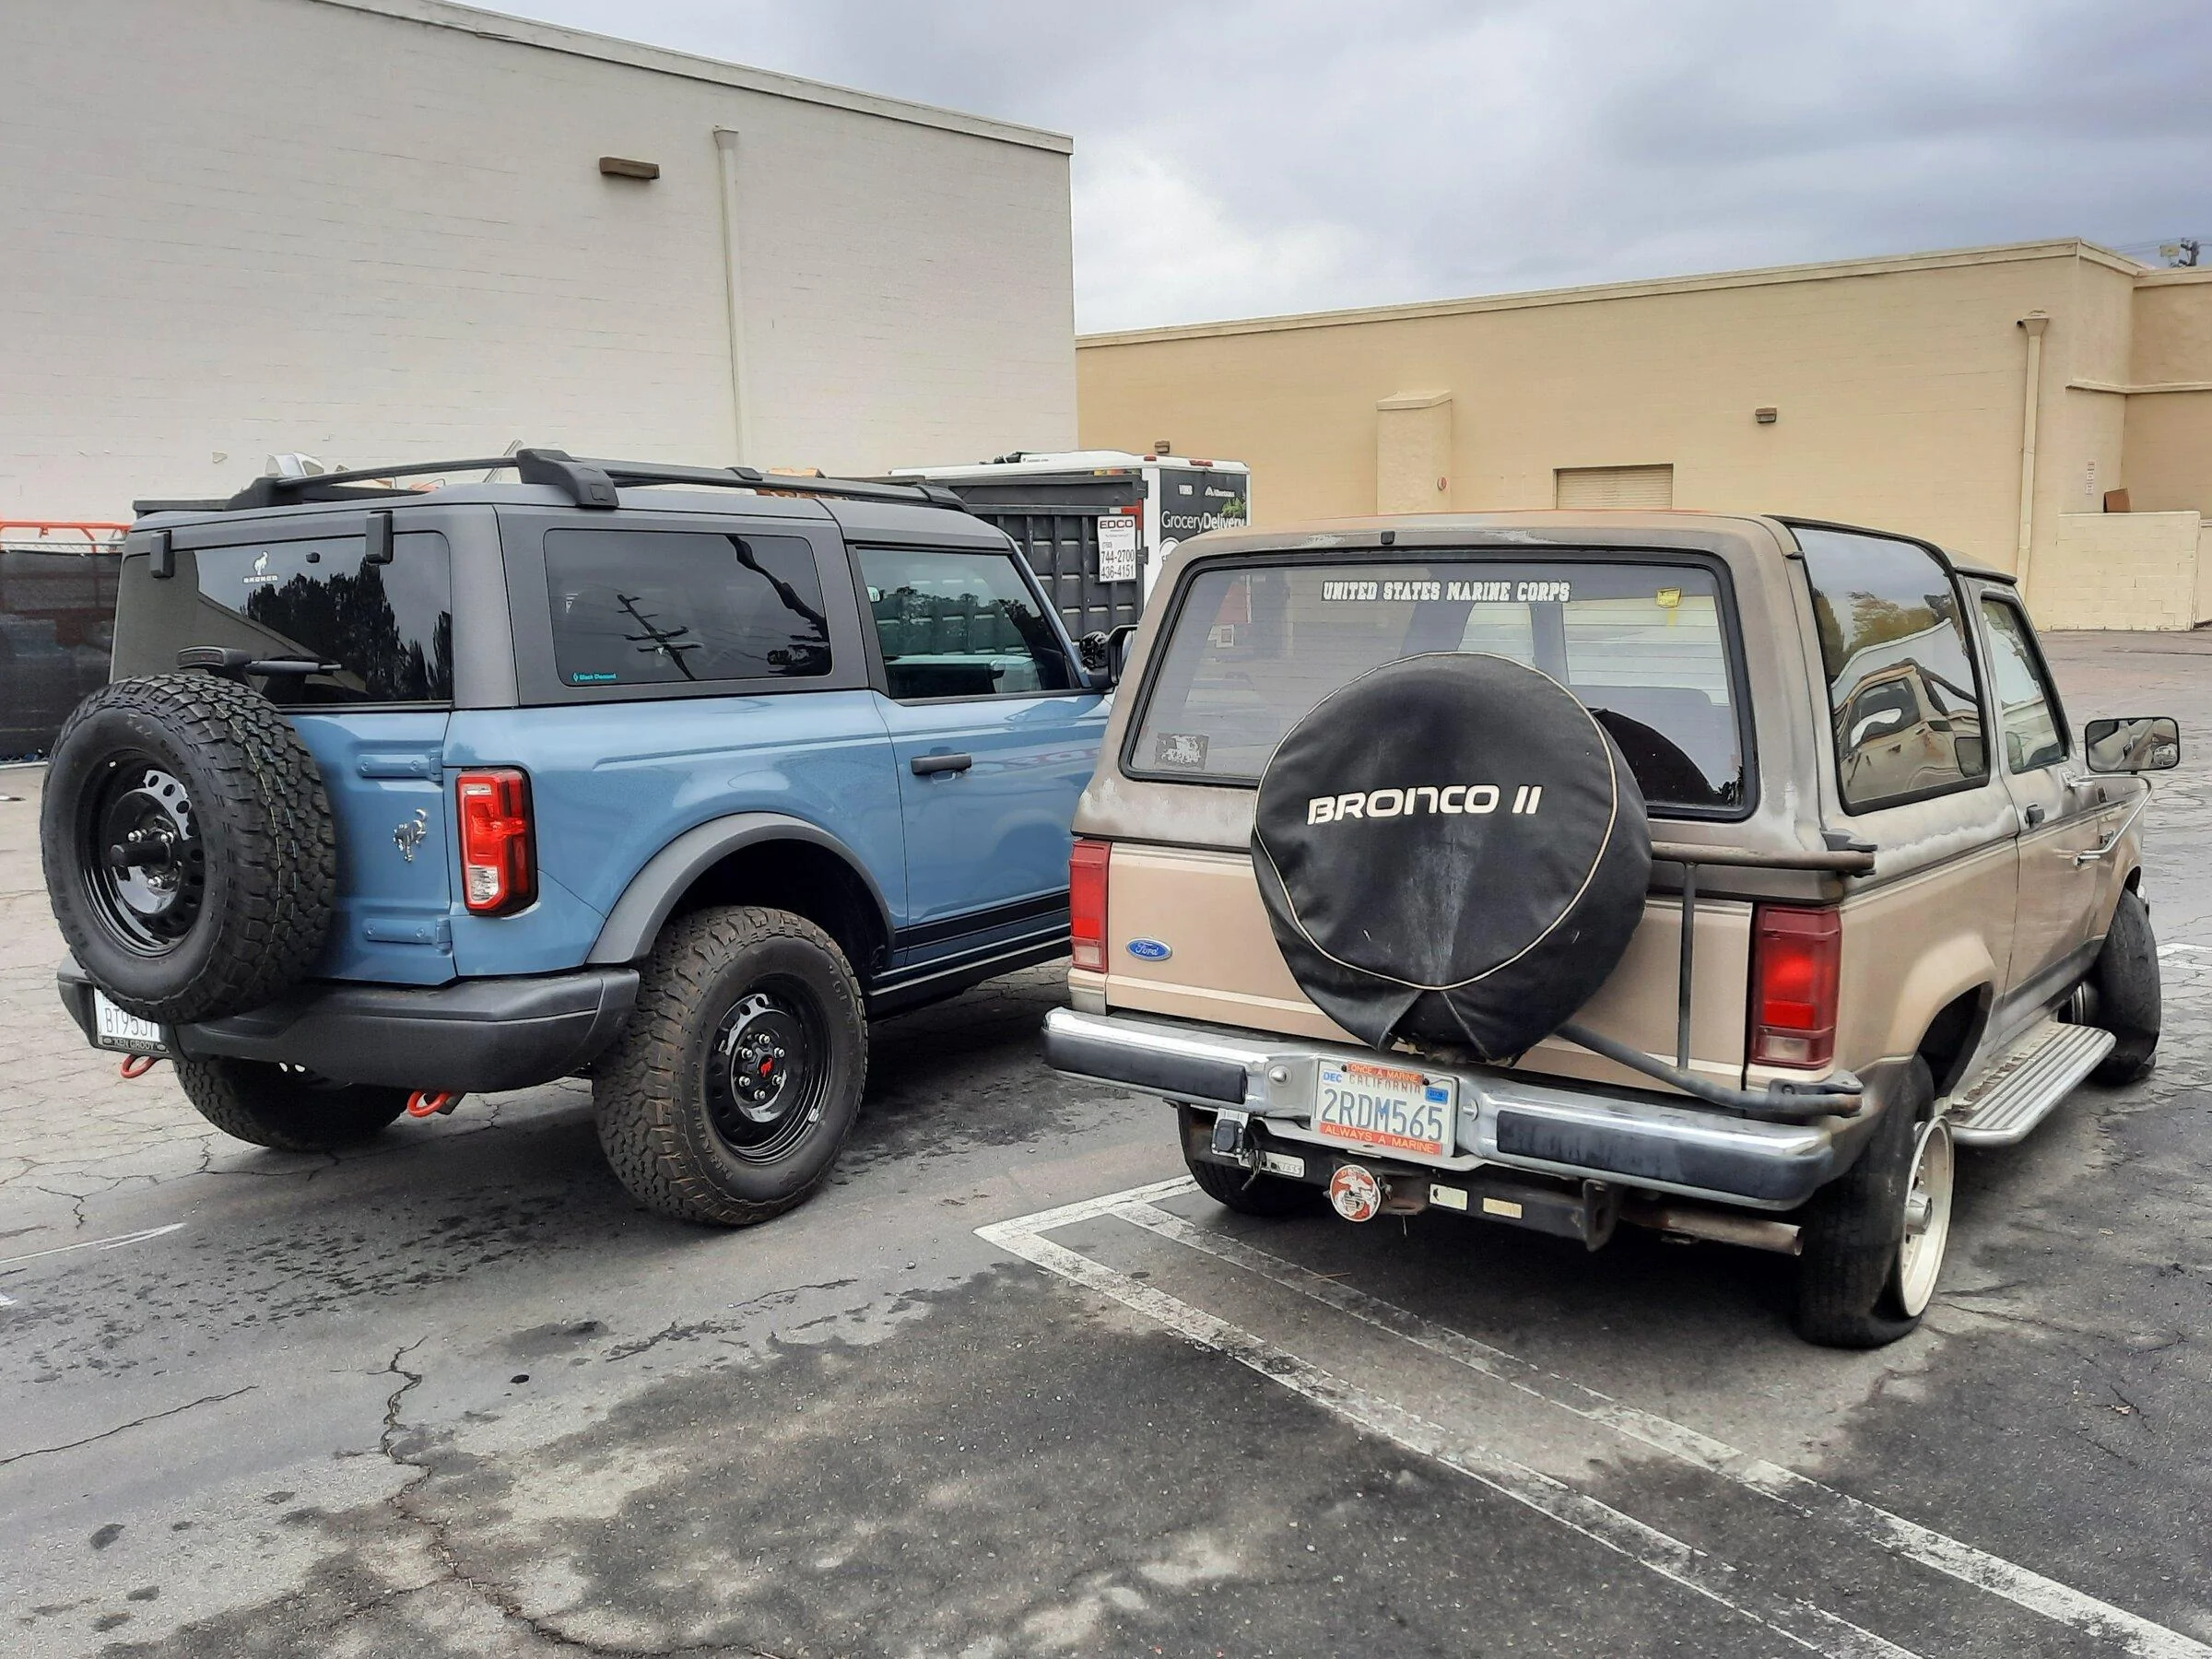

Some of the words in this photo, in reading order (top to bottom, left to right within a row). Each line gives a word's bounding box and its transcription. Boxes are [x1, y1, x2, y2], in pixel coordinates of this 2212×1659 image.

[1100, 519, 1134, 529] EDCO
[1100, 549, 1135, 563] 744-2700
[1100, 564, 1135, 580] 436-4151
[1323, 582, 1378, 601] UNITED
[1382, 582, 1441, 601] STATES
[1446, 582, 1512, 602] MARINE
[1516, 581, 1571, 602] CORPS
[1306, 784, 1500, 826] BRONCO
[1512, 785, 1543, 815] II
[1135, 941, 1159, 956] Ford
[1323, 1071, 1342, 1083] DEC
[1350, 1065, 1372, 1075] ONCE
[1377, 1069, 1383, 1077] A
[1386, 1070, 1418, 1082] MARINE
[1348, 1074, 1421, 1095] CALIFORNIA
[1321, 1088, 1443, 1142] 2RDM565
[1324, 1125, 1373, 1141] ALWAYS
[1378, 1134, 1386, 1144] A
[1392, 1138, 1435, 1155] MARINE
